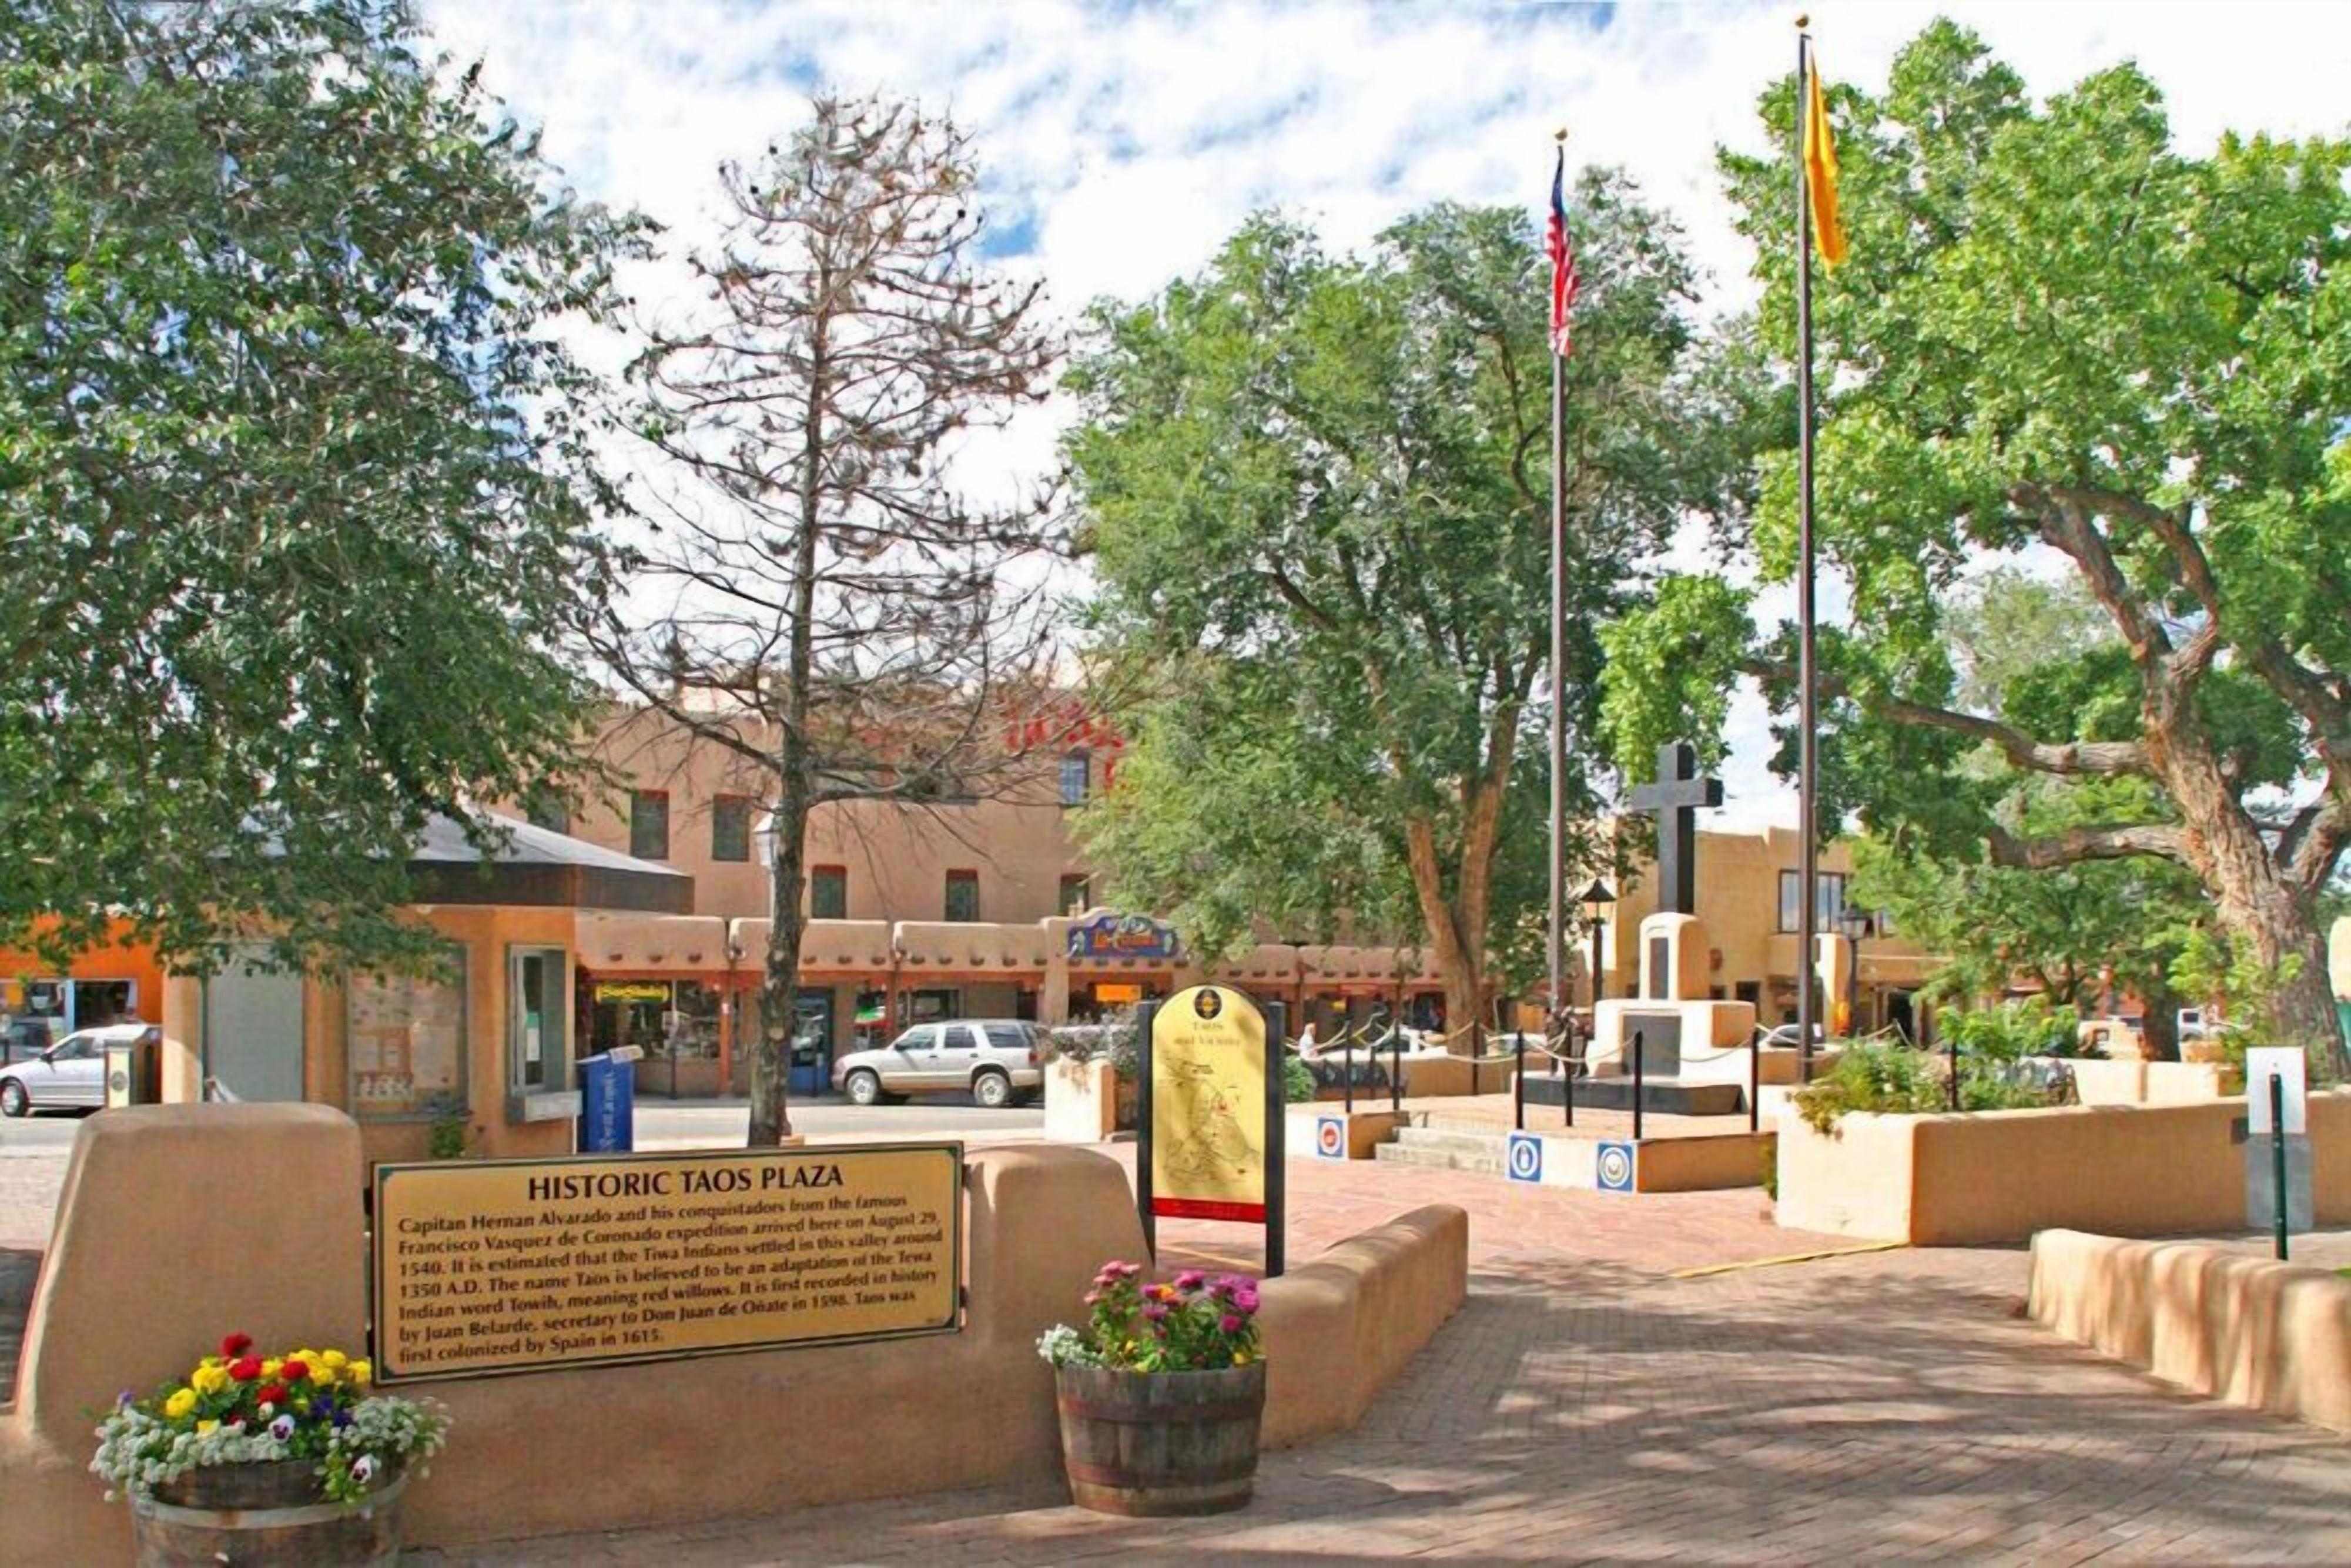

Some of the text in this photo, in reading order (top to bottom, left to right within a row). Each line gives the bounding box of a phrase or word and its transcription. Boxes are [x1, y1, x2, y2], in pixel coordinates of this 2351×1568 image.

[529, 1164, 844, 1201] HISTORIC TAOS PLAZA
[398, 1216, 466, 1238] Capitan
[540, 1208, 612, 1227] Alvarado
[617, 1207, 646, 1222] and
[651, 1205, 674, 1219] his
[678, 1200, 785, 1221] conquistadors
[791, 1197, 823, 1212] from
[828, 1195, 851, 1210] the
[856, 1194, 907, 1209] famous
[398, 1239, 480, 1255] Francisco
[558, 1231, 578, 1247] de
[583, 1228, 661, 1244] Coronado
[666, 1222, 748, 1241] expedition
[753, 1218, 805, 1235] arrived
[809, 1215, 841, 1231] here
[846, 1218, 864, 1229] on
[868, 1211, 915, 1230] August
[400, 1228, 943, 1277] 1540. It is estimated that the Tiwa Indians settled in this valley around
[400, 1282, 442, 1298] 1350
[447, 1279, 483, 1295] A.D.
[489, 1277, 520, 1292] The
[524, 1277, 569, 1289] name
[576, 1271, 610, 1286] Taos
[615, 1268, 628, 1284] is
[633, 1264, 699, 1282] believed
[705, 1264, 720, 1277] to
[724, 1260, 744, 1276] be
[748, 1262, 766, 1274] an
[771, 1255, 849, 1278] adaptation
[852, 1252, 868, 1267] of
[871, 1251, 894, 1265] the
[398, 1303, 455, 1321] Indian
[460, 1298, 503, 1315] word
[567, 1291, 638, 1308] meaning
[642, 1286, 669, 1302] red
[674, 1282, 734, 1299] willows.
[739, 1281, 751, 1294] It
[755, 1278, 768, 1292] is
[772, 1276, 801, 1292] first
[804, 1271, 869, 1290] recorded
[873, 1270, 887, 1285] in
[891, 1268, 937, 1284] history
[399, 1326, 420, 1344] by
[425, 1324, 464, 1342] Juan
[542, 1313, 617, 1332] secretary
[621, 1310, 638, 1324] to
[642, 1308, 676, 1323] Don
[679, 1305, 715, 1322] Juan
[718, 1301, 738, 1316] de
[792, 1295, 808, 1311] in
[855, 1292, 886, 1305] Taos
[889, 1292, 916, 1303] was
[399, 1329, 663, 1363] first colonized by Spain in 1615.
